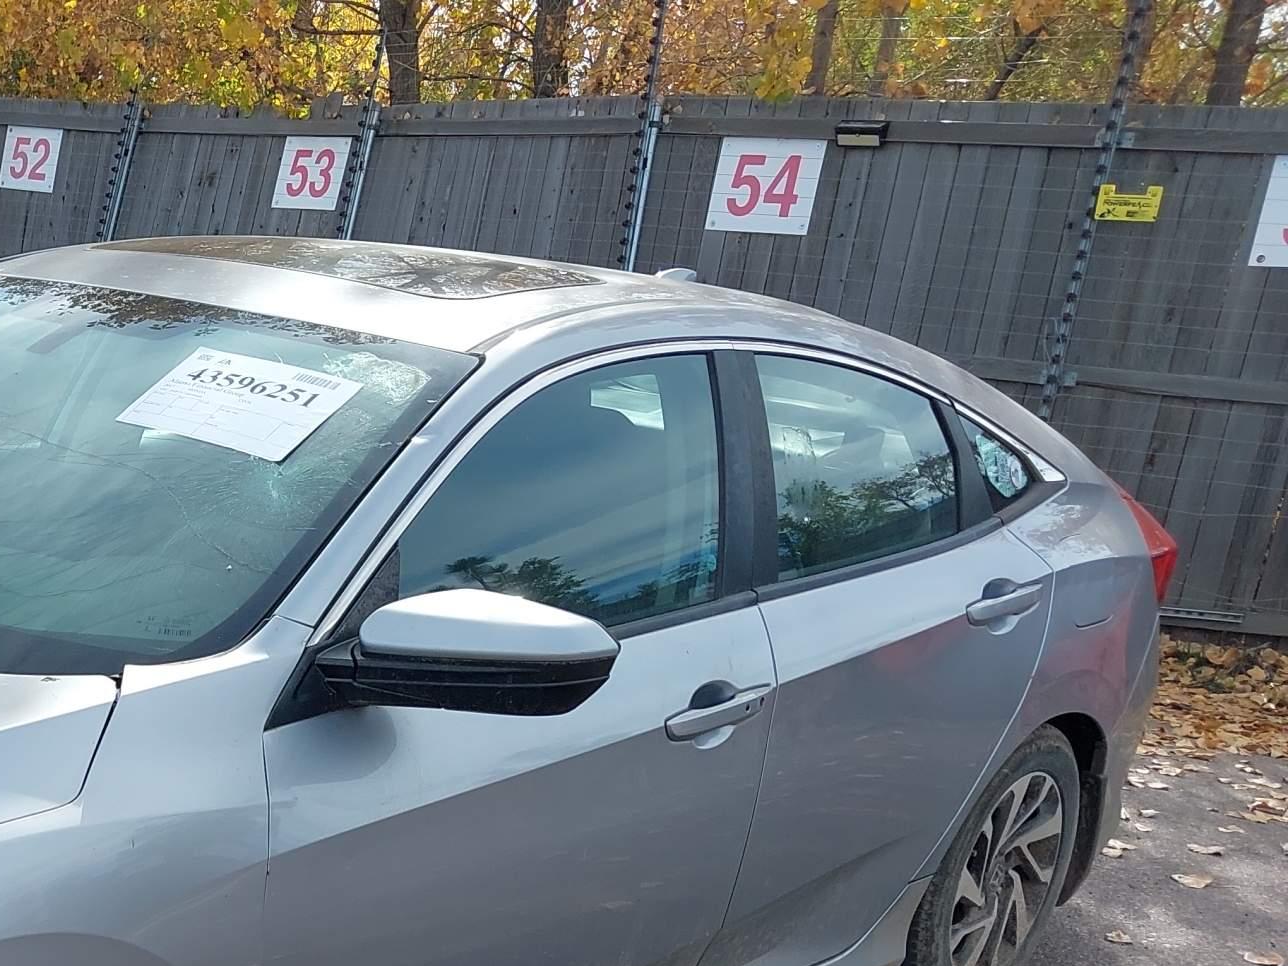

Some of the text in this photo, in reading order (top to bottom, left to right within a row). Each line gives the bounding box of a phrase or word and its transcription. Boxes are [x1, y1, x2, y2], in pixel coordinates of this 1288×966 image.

[9, 136, 52, 181] 52
[285, 148, 336, 198] 53
[726, 153, 802, 218] 54
[187, 367, 321, 408] 43596251
